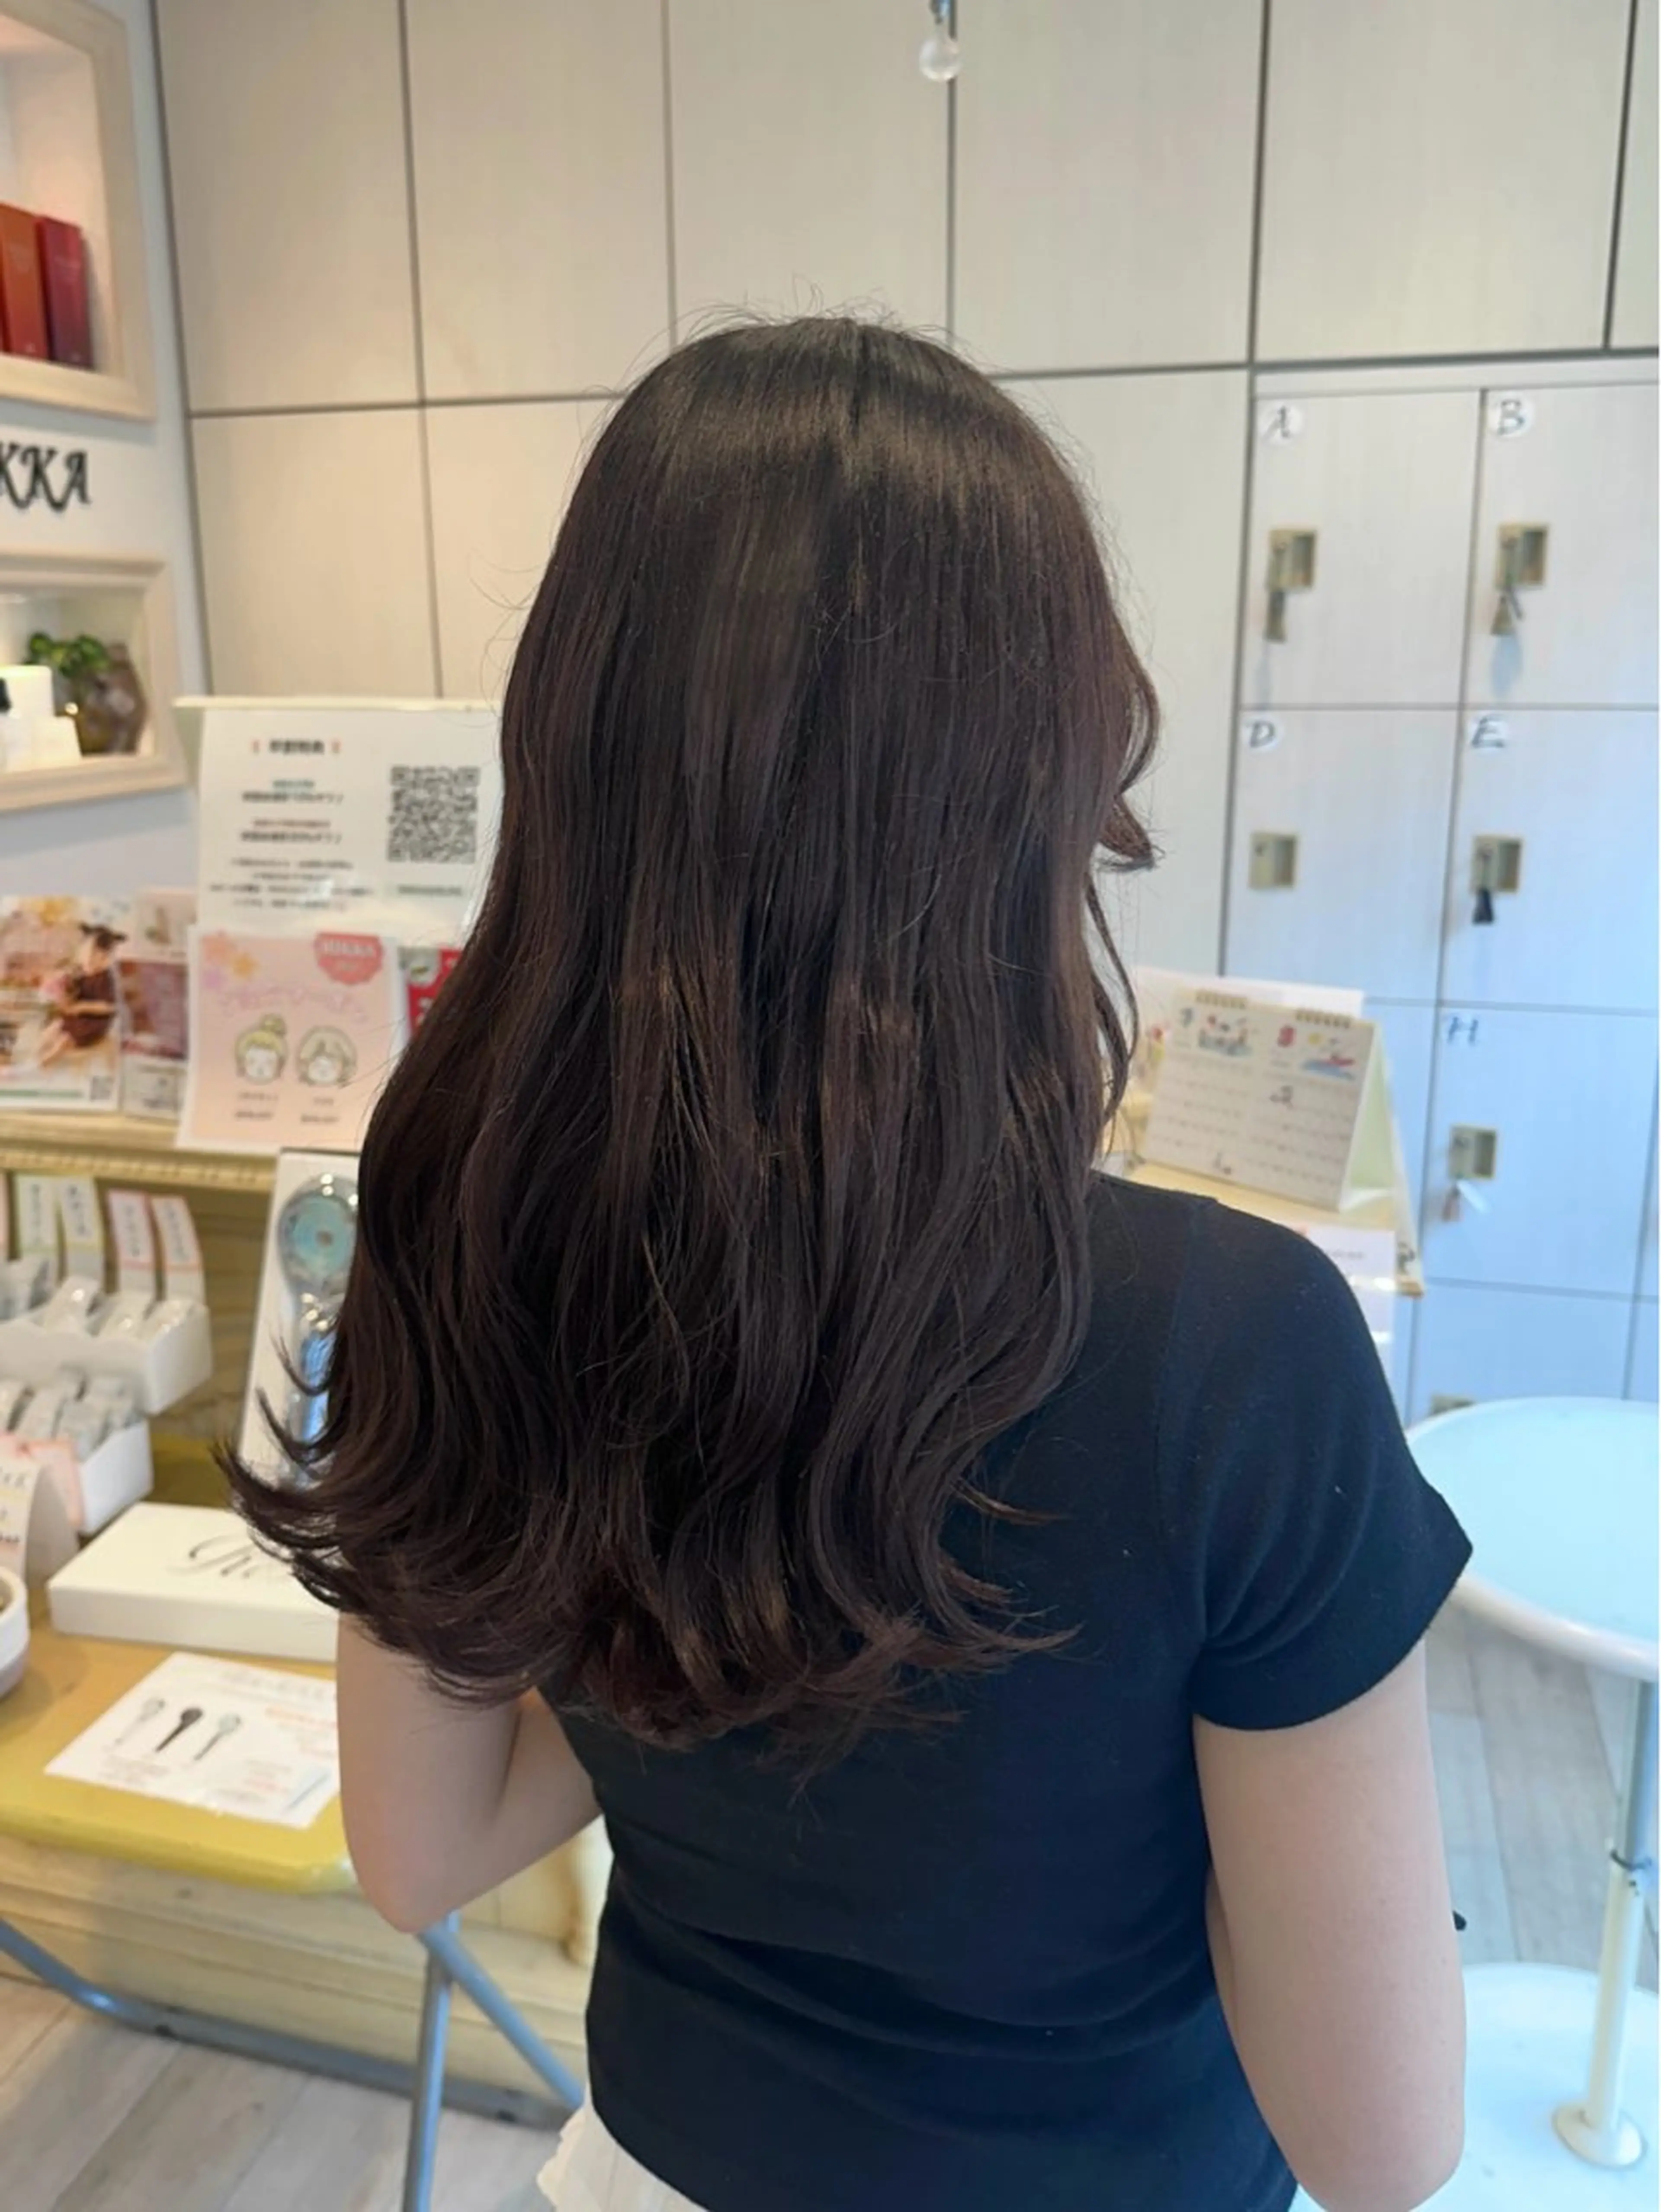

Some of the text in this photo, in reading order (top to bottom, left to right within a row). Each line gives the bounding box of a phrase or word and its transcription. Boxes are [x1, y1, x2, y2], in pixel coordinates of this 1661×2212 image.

[1263, 405, 1292, 439] A
[1497, 398, 1525, 435] B
[1248, 719, 1275, 749] D
[1471, 716, 1505, 749] E
[1447, 1016, 1479, 1044] H
